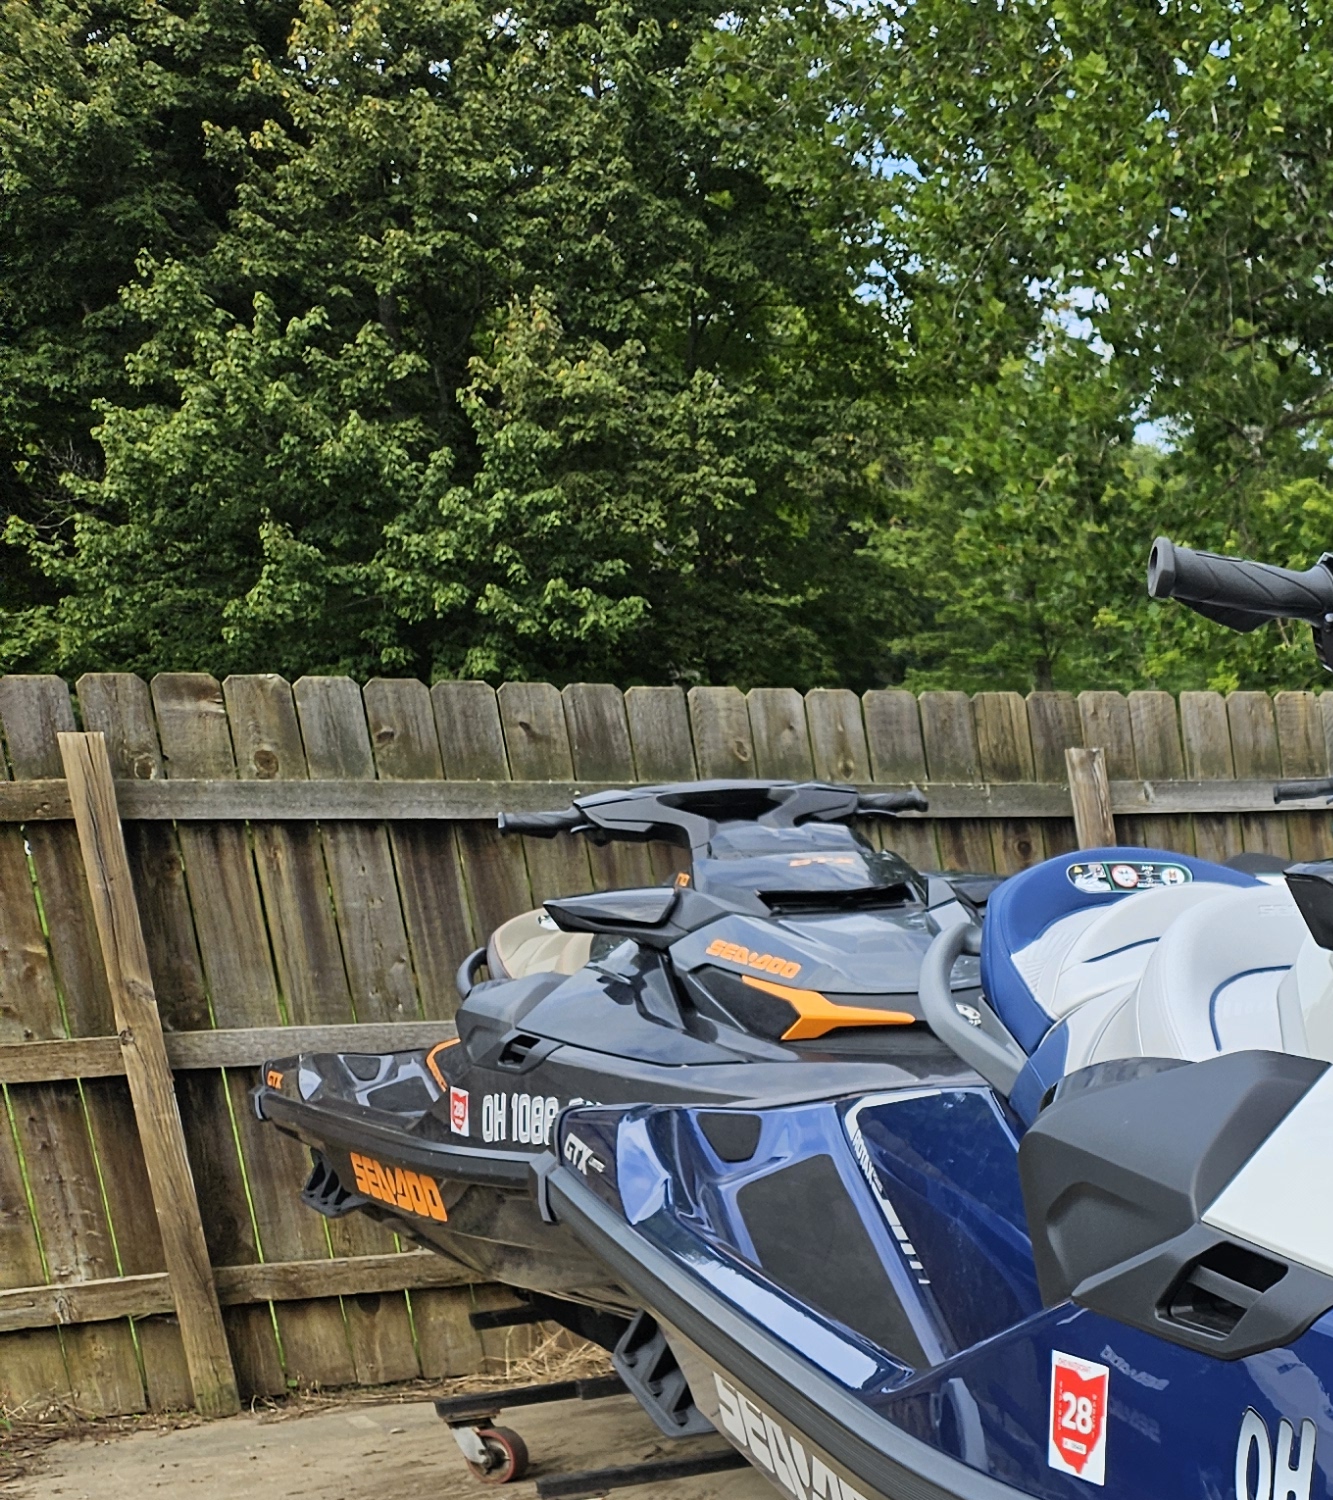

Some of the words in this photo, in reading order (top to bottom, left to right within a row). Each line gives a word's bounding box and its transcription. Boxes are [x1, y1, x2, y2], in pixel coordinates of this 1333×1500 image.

[482, 1092, 507, 1143] OH
[563, 1132, 594, 1175] GTX
[1061, 1390, 1094, 1435] 28
